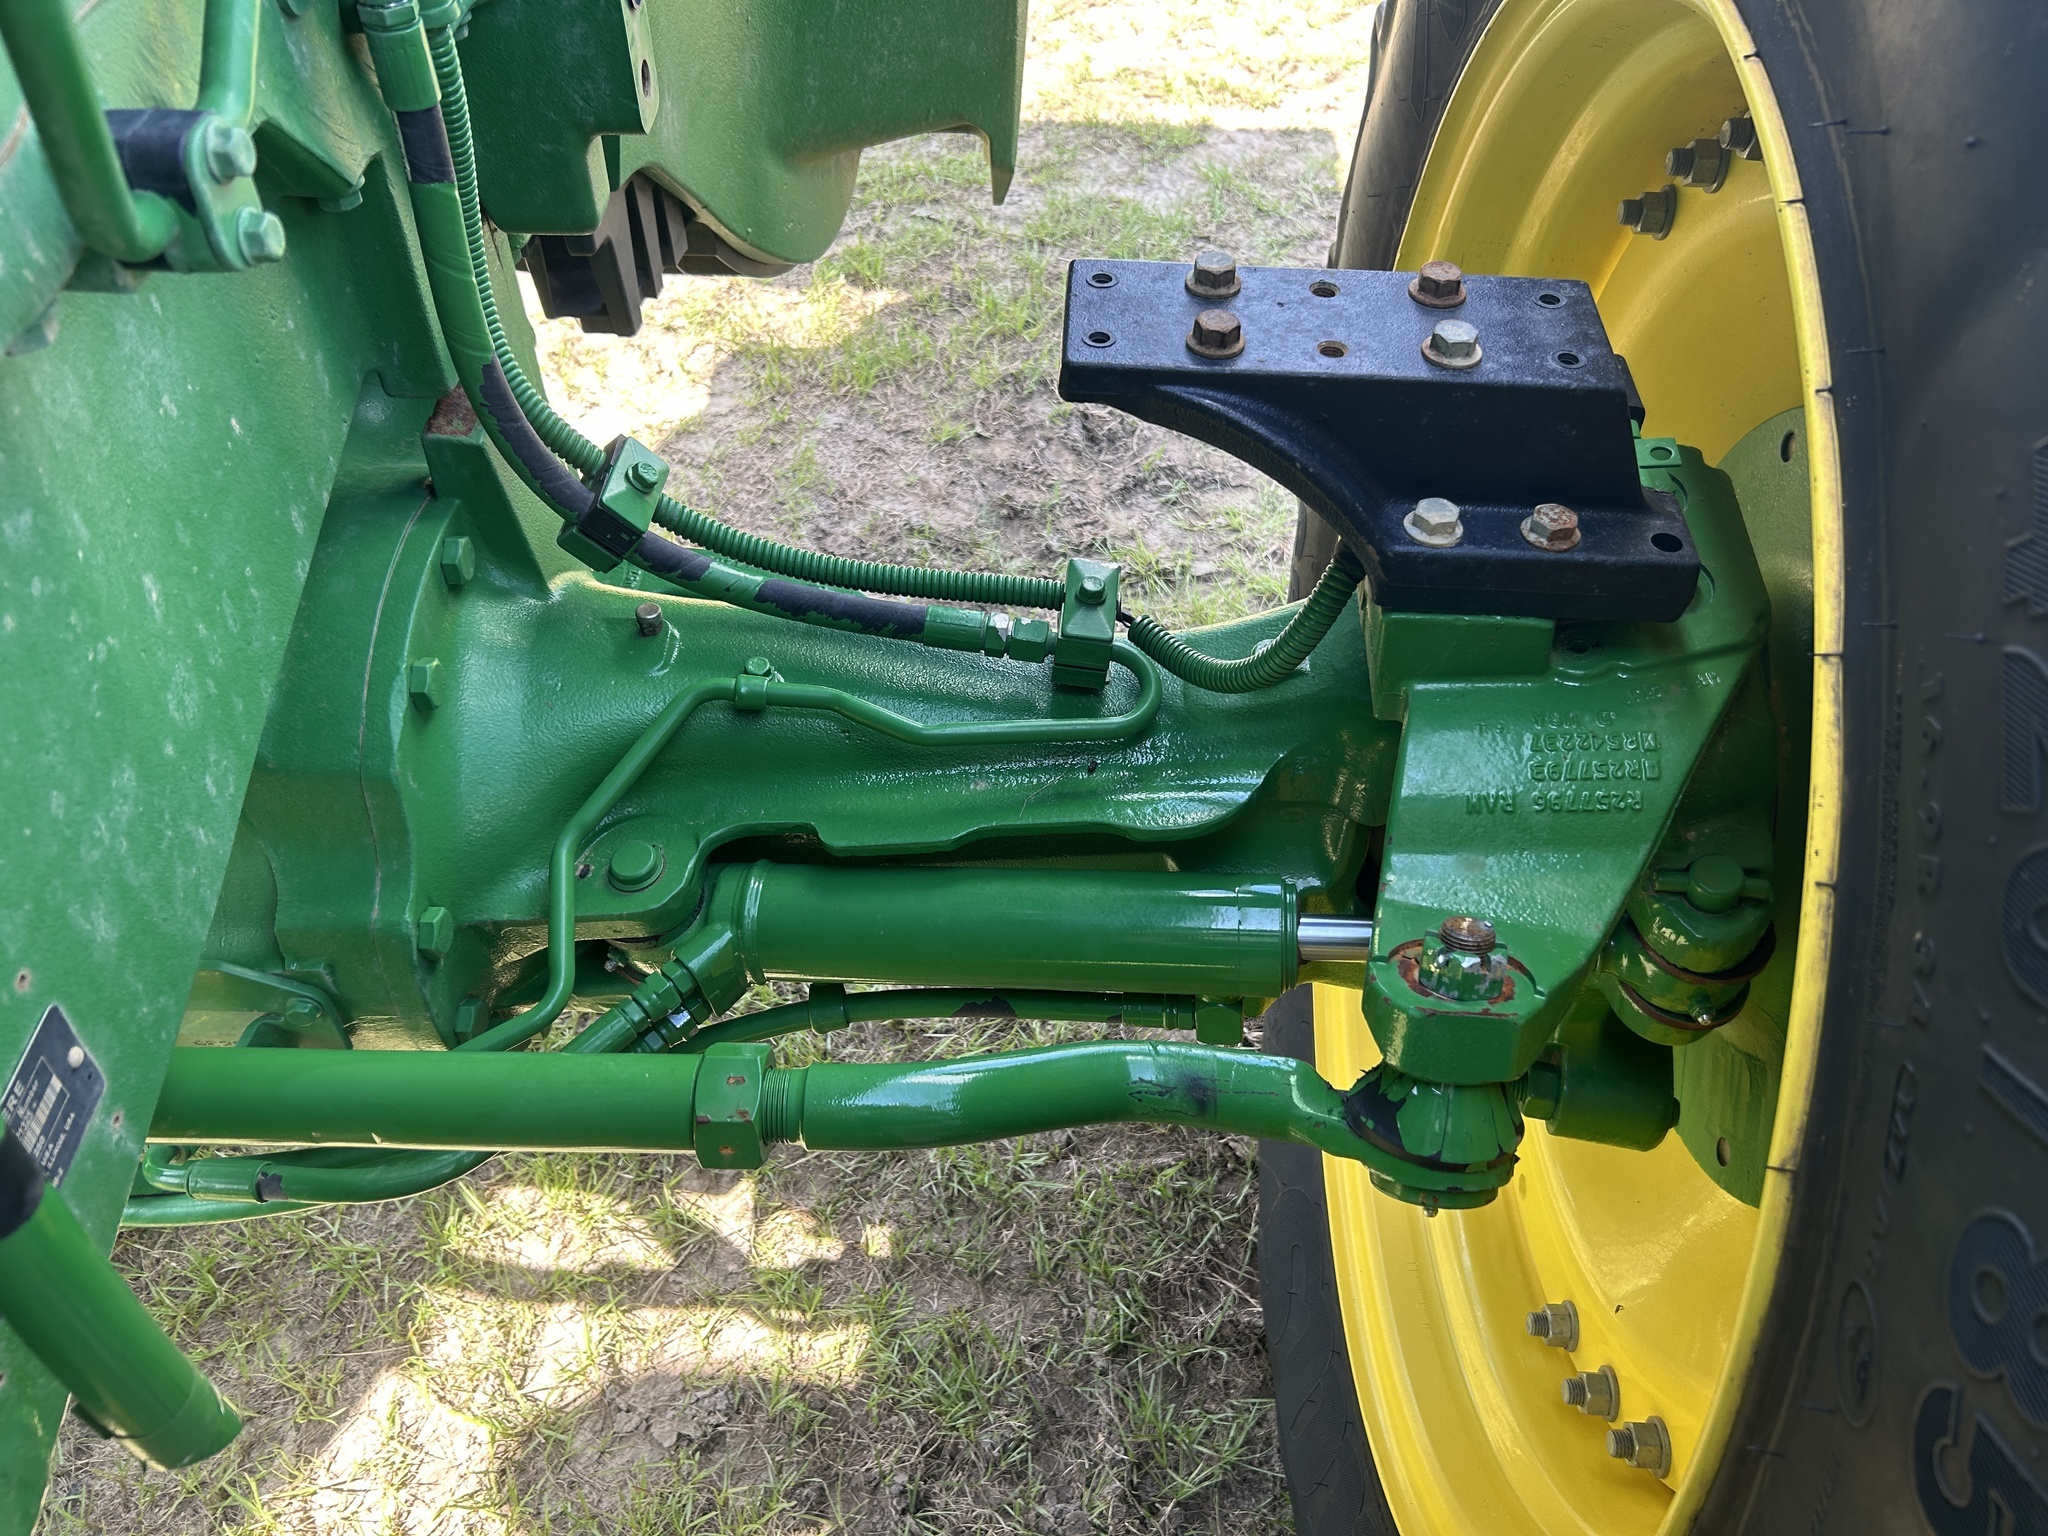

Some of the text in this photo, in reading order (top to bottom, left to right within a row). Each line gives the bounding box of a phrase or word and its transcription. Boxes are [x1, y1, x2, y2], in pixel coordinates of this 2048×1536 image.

[1531, 711, 1578, 728] USA
[1530, 732, 1637, 753] R542237
[1527, 760, 1640, 781] R257793
[1531, 791, 1643, 814] R257796
